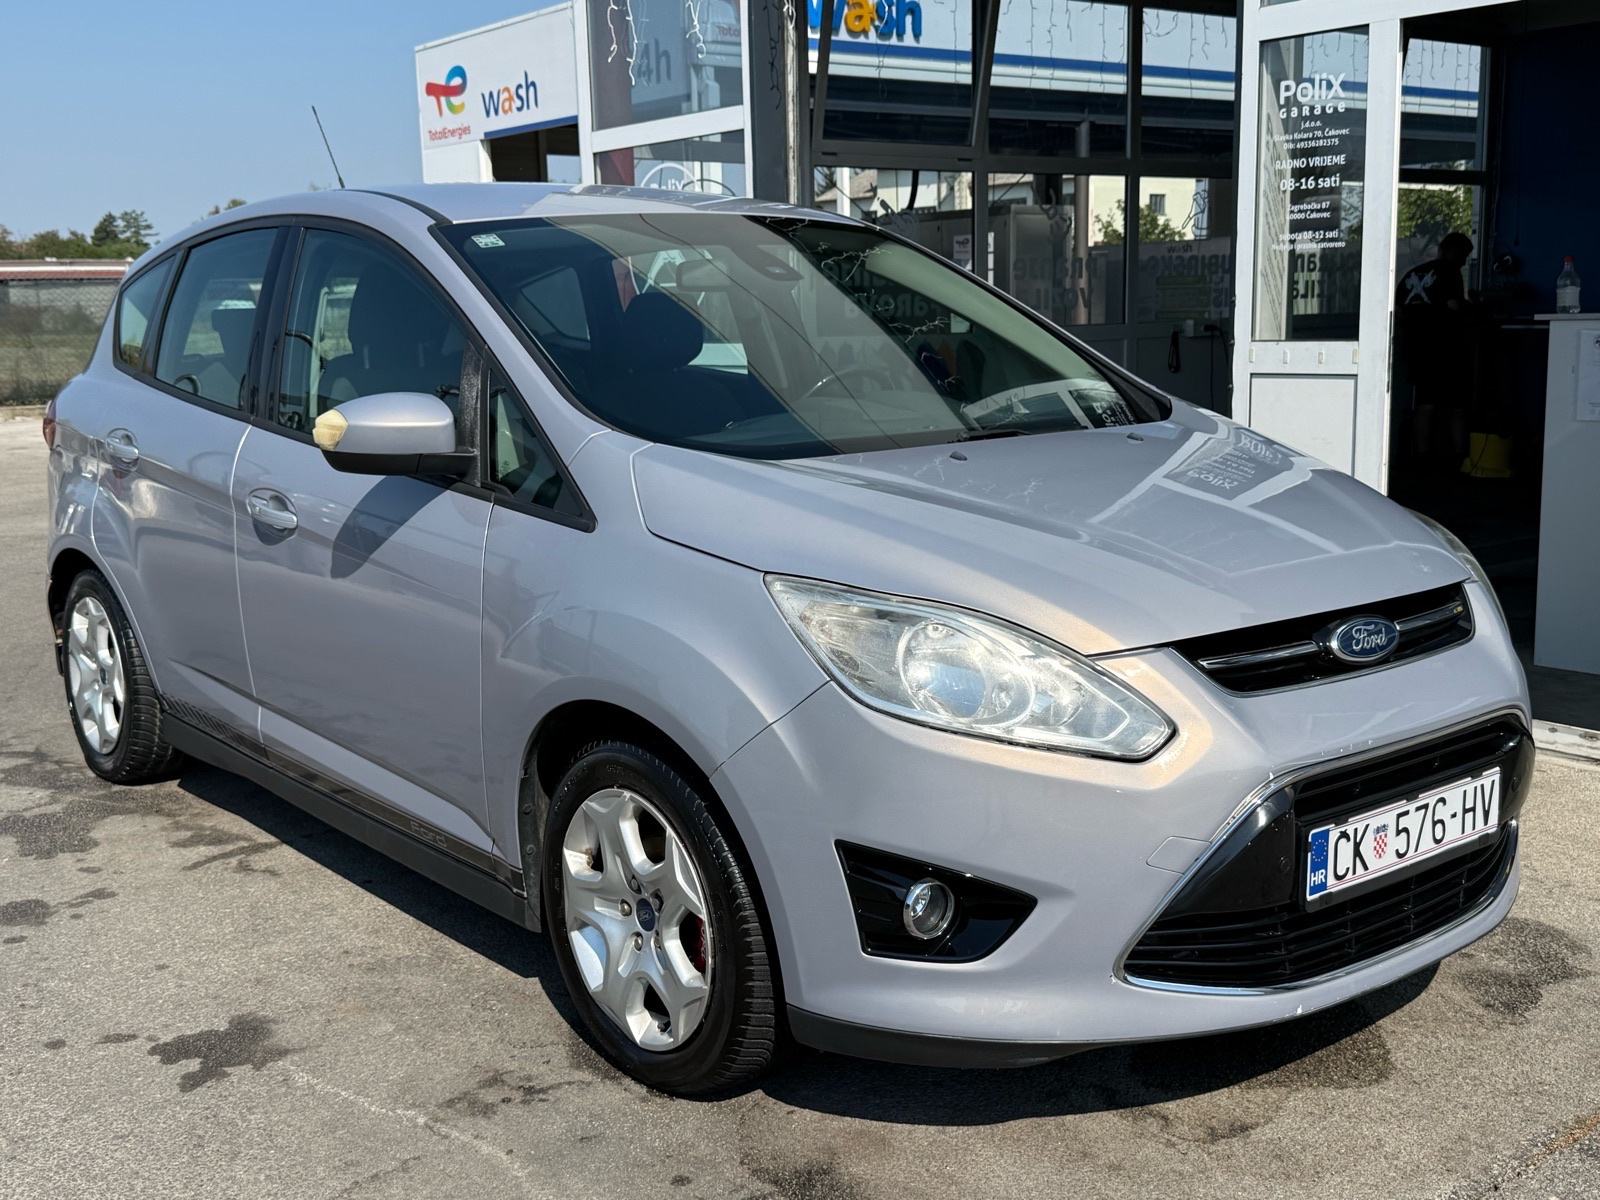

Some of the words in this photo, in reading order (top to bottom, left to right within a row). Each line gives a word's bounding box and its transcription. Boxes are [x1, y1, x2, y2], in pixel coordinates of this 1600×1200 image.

[481, 71, 538, 119] wash
[428, 124, 471, 141] TotalEnergies
[1275, 157, 1307, 170] RADNO
[1309, 154, 1346, 167] VRIJEME
[1280, 176, 1316, 191] 08-16
[1318, 173, 1340, 188] sati
[1352, 624, 1387, 651] Ford
[1333, 822, 1370, 881] ČK
[1394, 779, 1496, 860] 576-HV
[1310, 870, 1326, 887] HR
